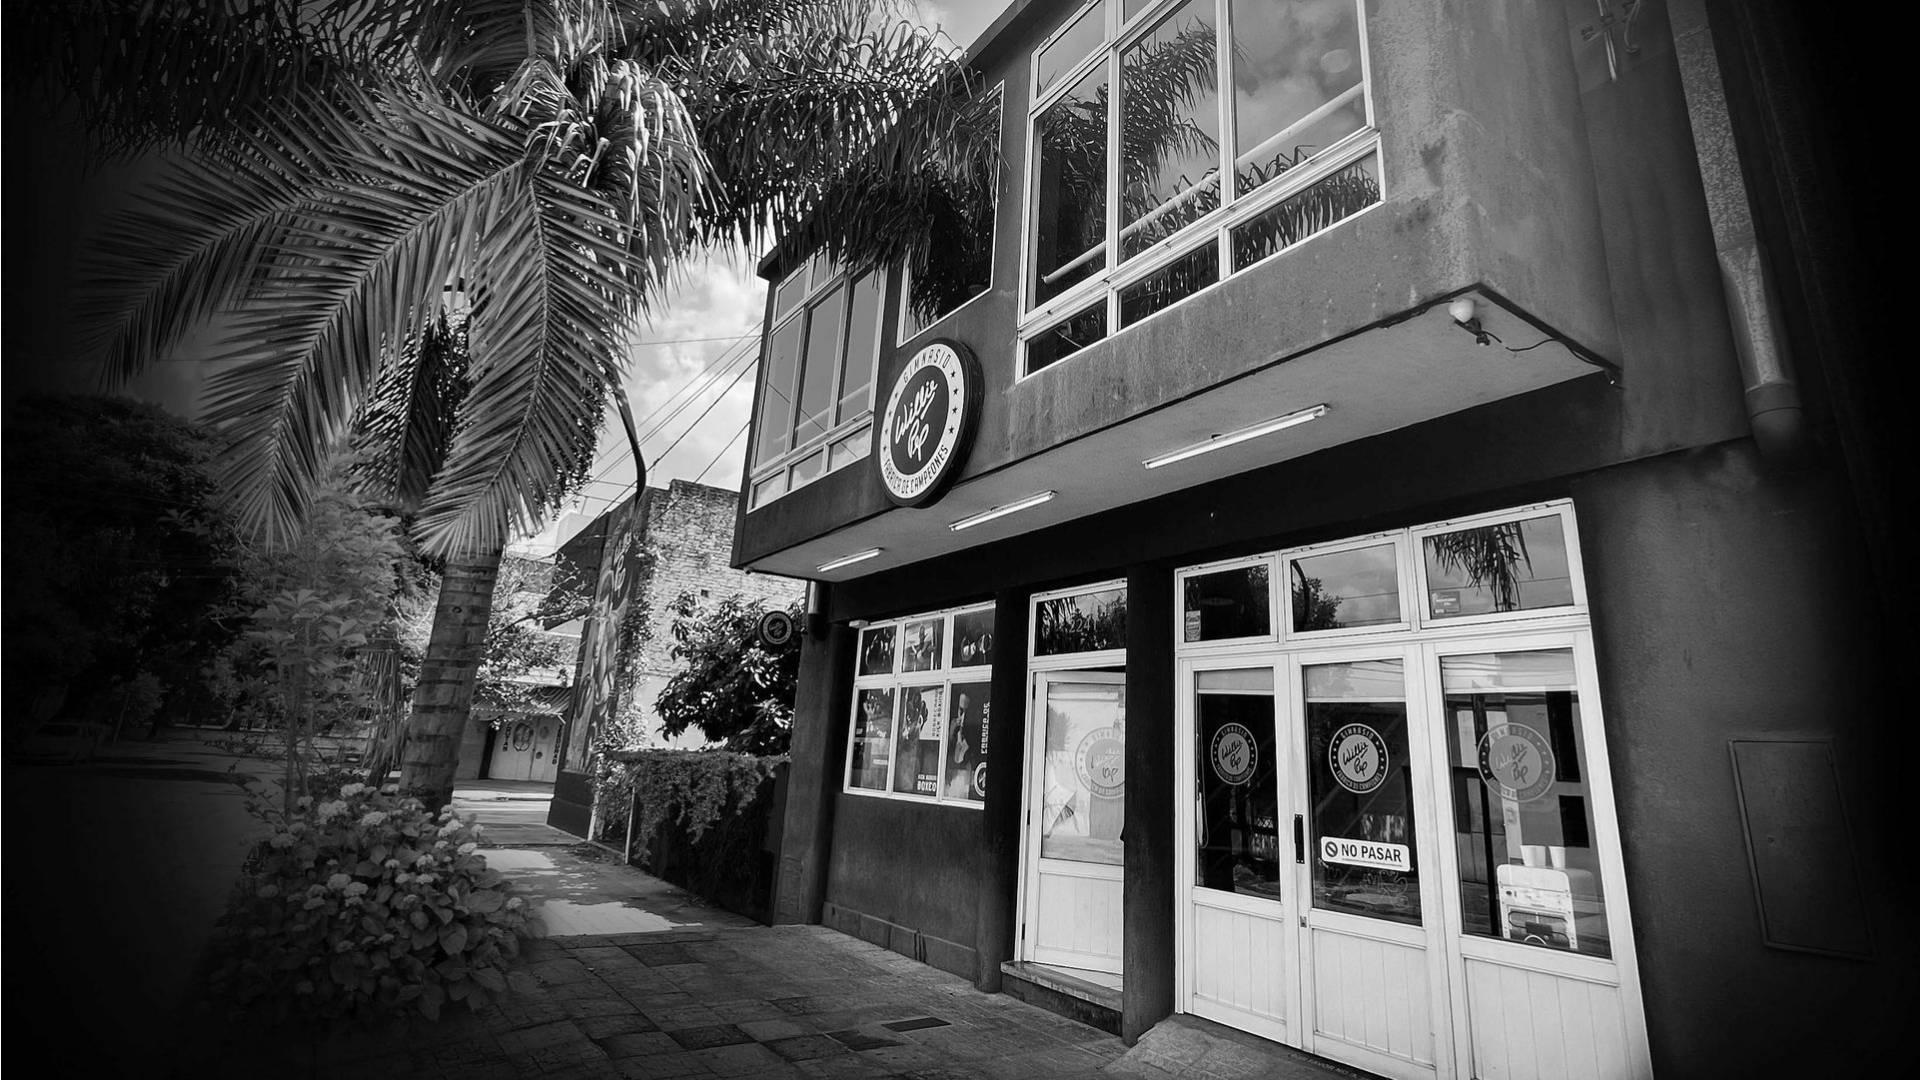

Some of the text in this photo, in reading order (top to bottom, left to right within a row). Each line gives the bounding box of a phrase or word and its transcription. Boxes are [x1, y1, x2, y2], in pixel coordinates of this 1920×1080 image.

[903, 348, 952, 384] GIMNASIO
[910, 444, 949, 494] CAMPEONES
[1341, 843, 1358, 858] NO
[1361, 845, 1402, 863] PASAR
